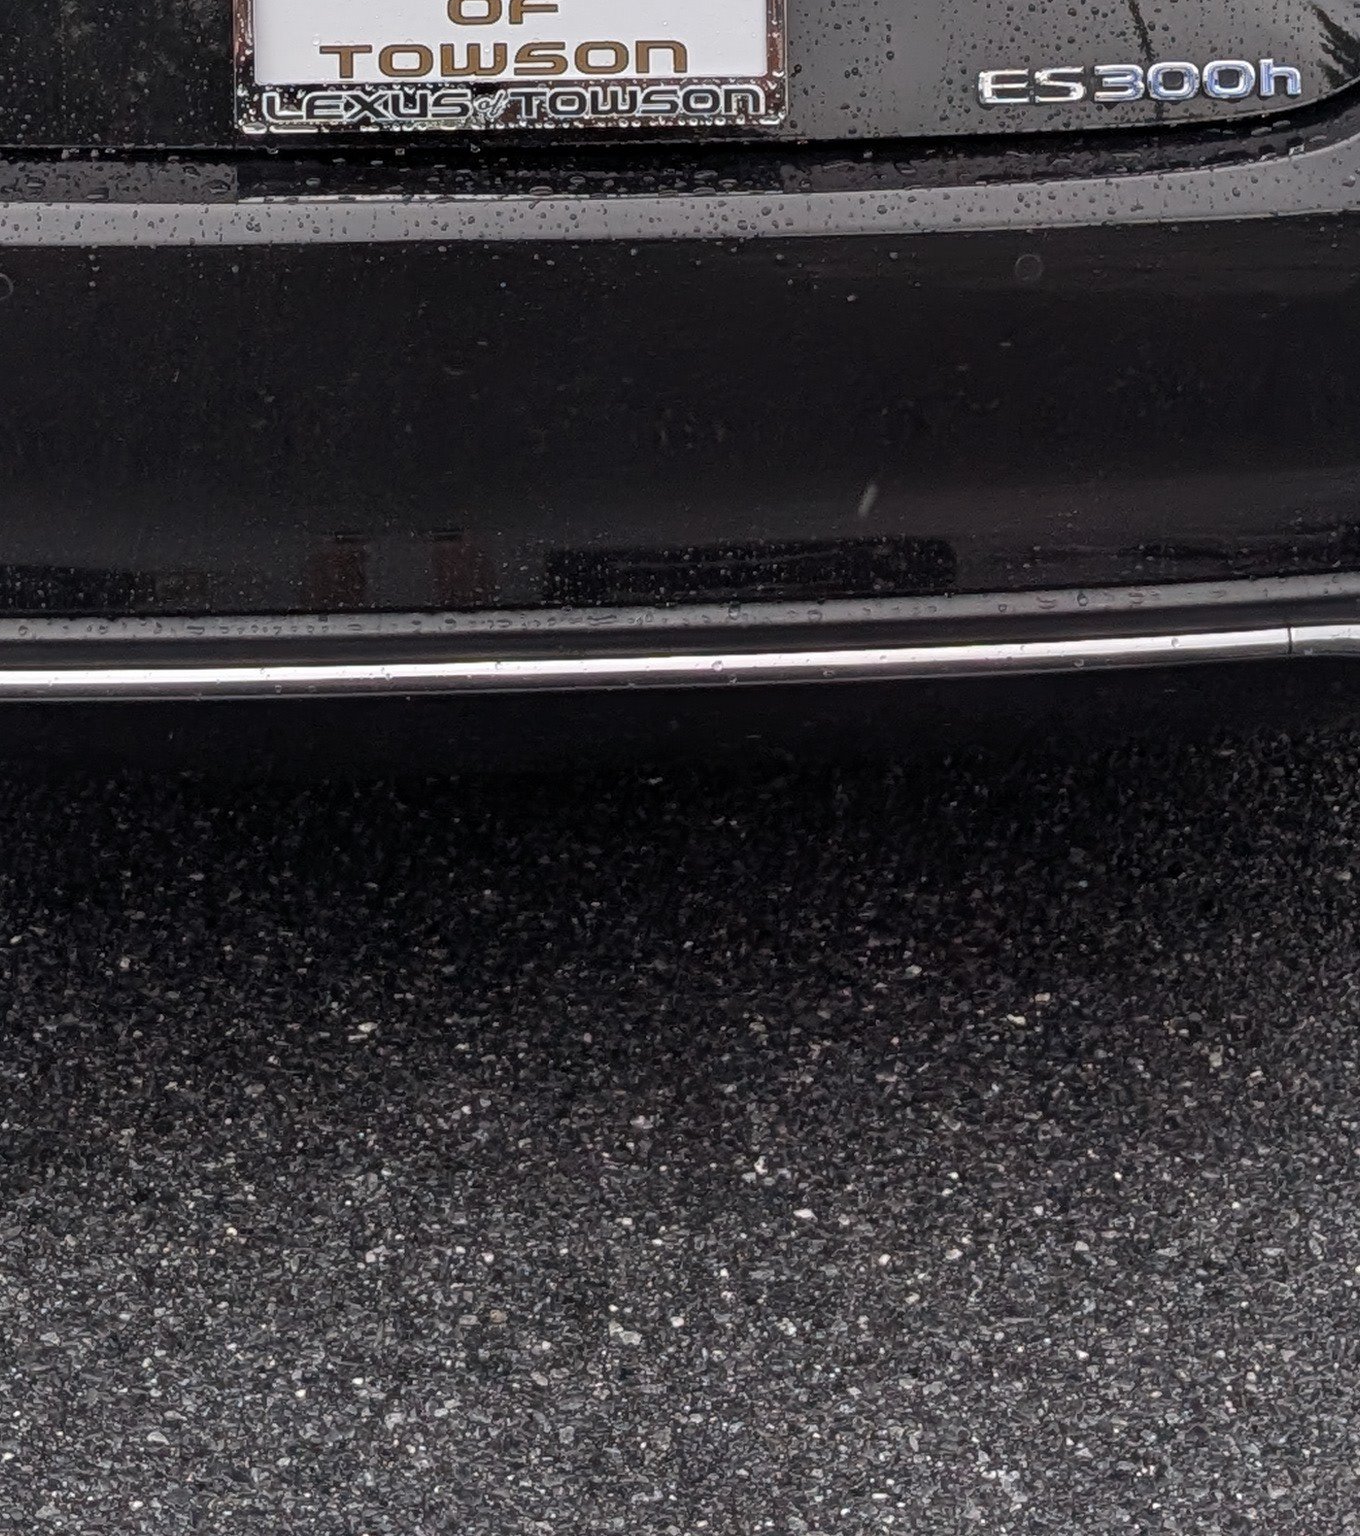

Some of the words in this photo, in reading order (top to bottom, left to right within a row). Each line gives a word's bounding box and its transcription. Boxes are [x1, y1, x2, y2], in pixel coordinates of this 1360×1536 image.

[320, 40, 689, 79] TOWSON
[262, 89, 470, 121] LEXUS
[508, 86, 765, 118] TOWSON
